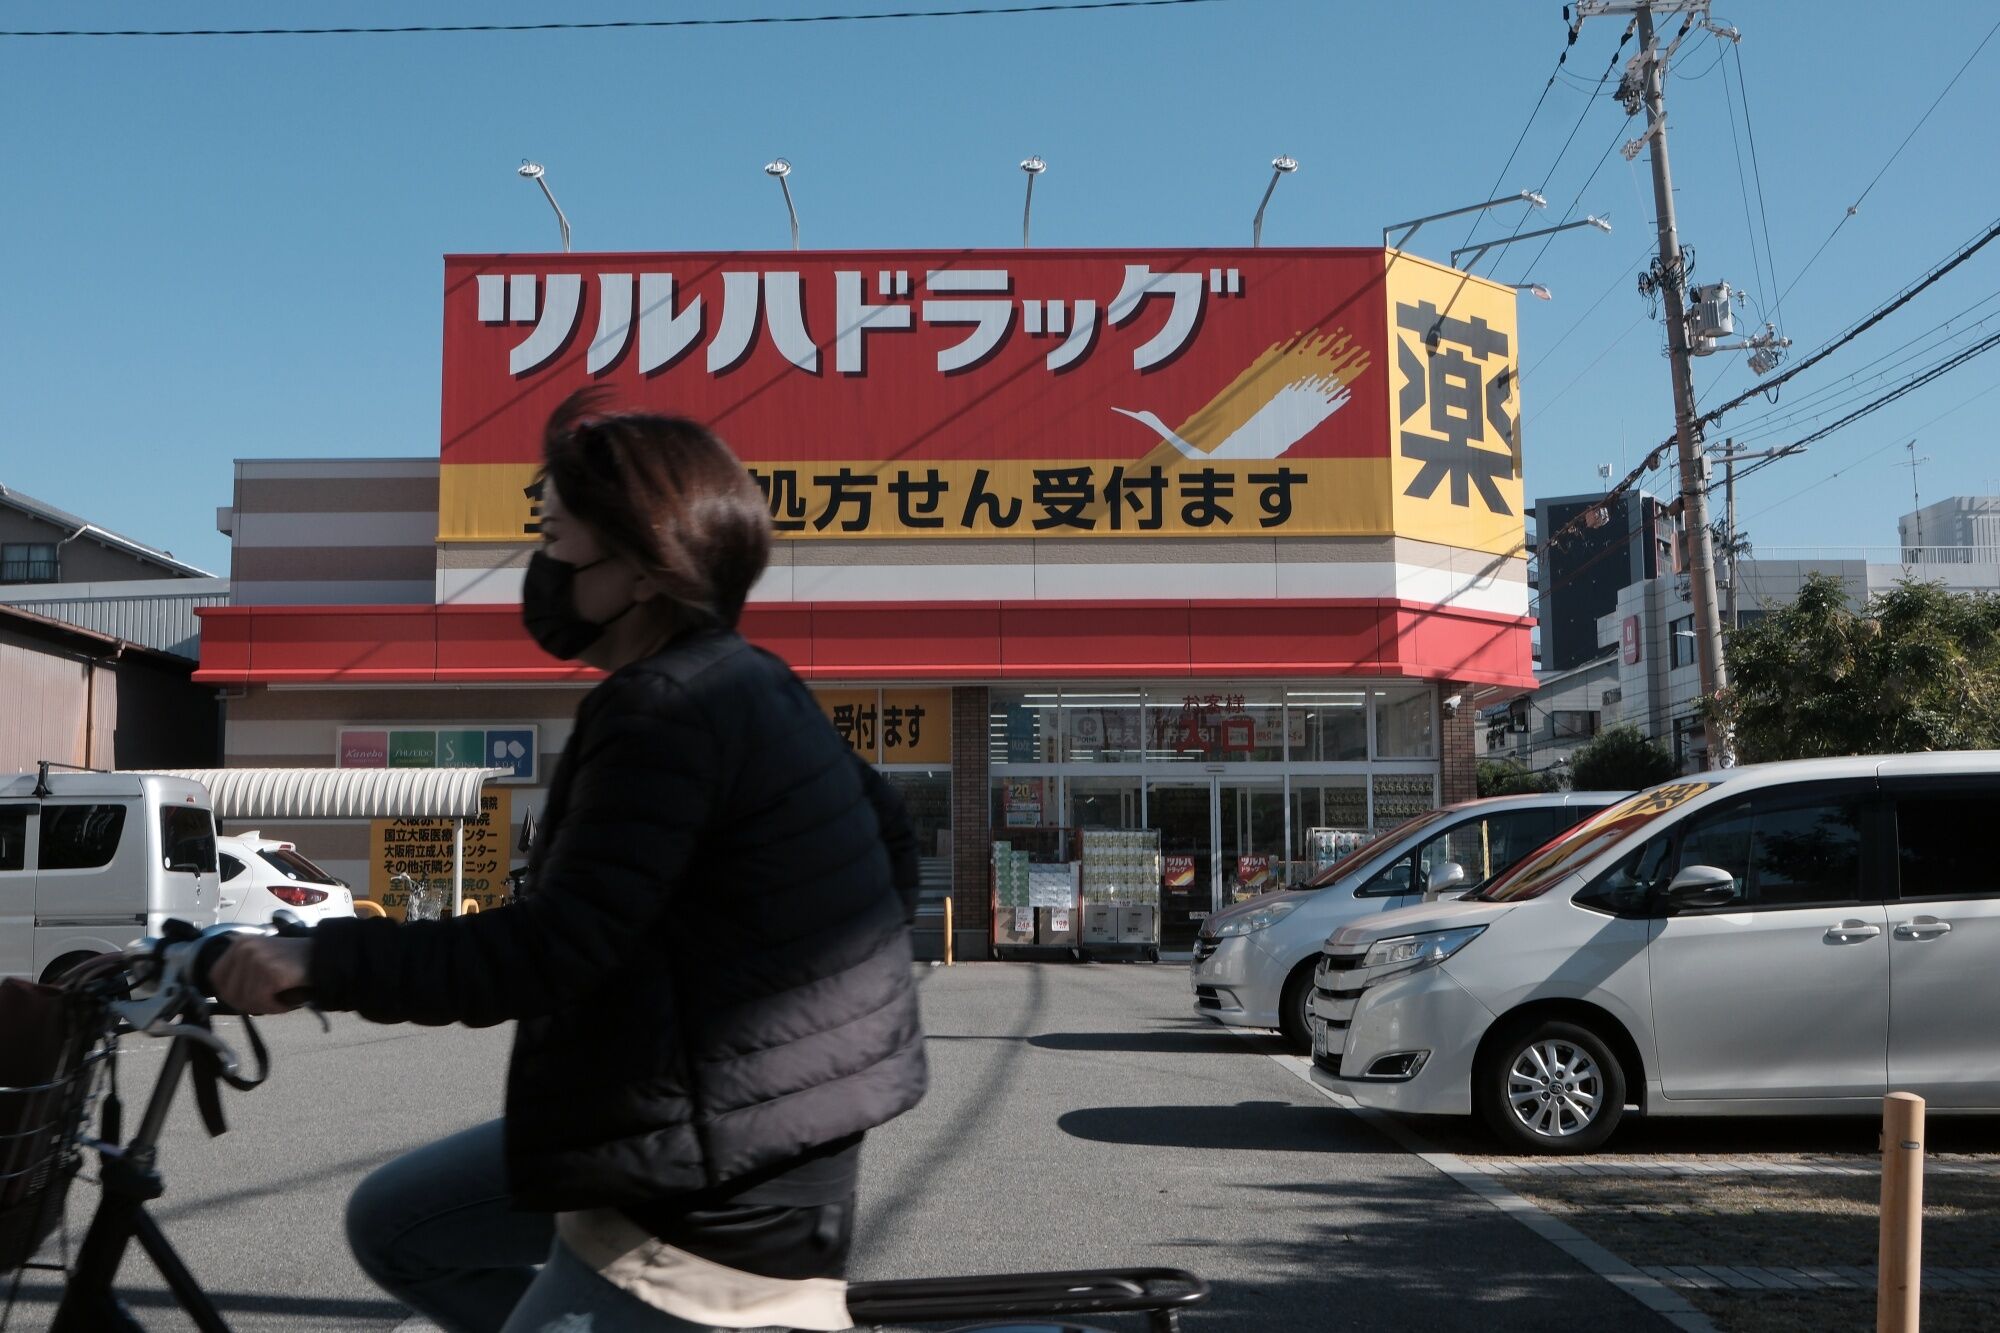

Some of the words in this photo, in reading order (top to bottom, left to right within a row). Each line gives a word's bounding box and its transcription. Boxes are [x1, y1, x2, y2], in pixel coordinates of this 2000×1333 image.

[475, 264, 1241, 378] ツルハドラッグ
[1396, 300, 1519, 517] 薬
[1183, 694, 1245, 714] お客様
[833, 703, 926, 751] 受付ます
[1176, 718, 1255, 753] 入口
[345, 748, 384, 759] Kanebo
[394, 748, 434, 758] SHISEIDO
[384, 828, 498, 843] 国立大阪医療ンター
[384, 860, 498, 874] その他近隣クニック
